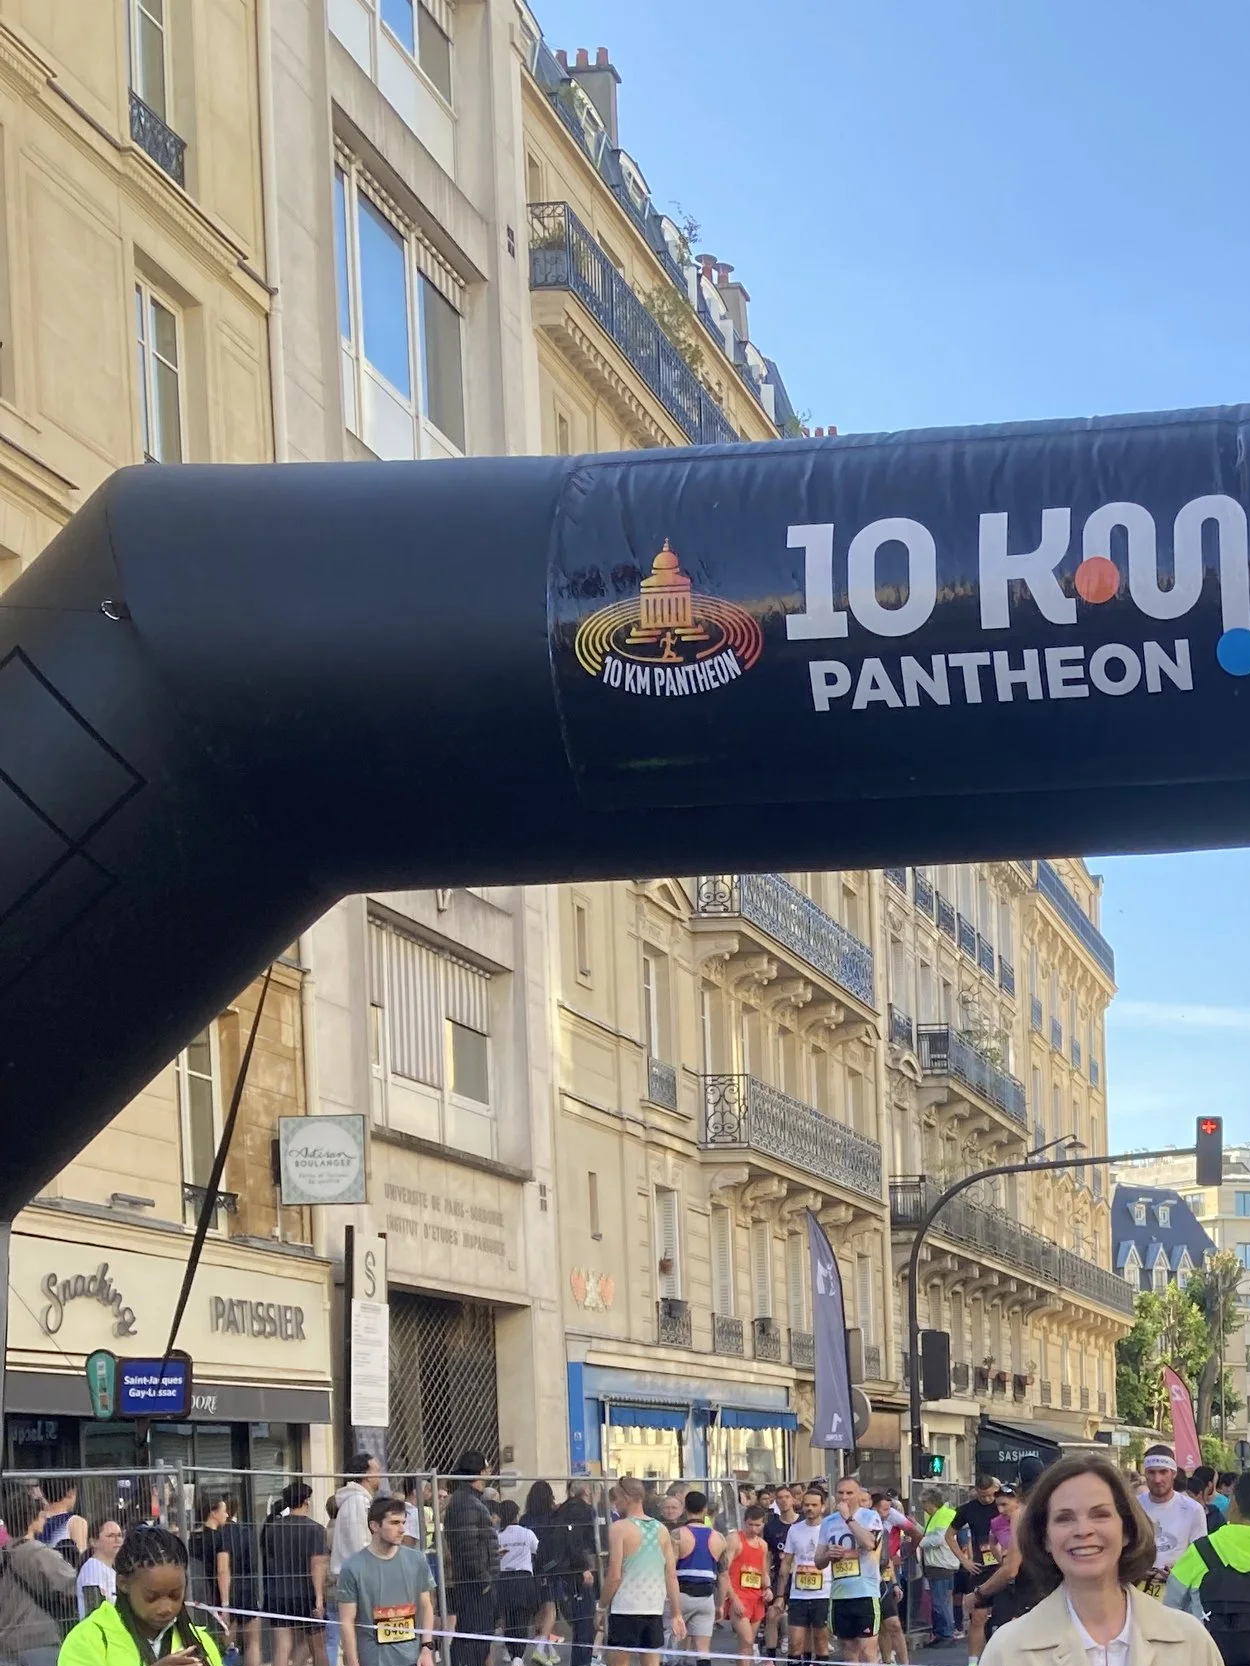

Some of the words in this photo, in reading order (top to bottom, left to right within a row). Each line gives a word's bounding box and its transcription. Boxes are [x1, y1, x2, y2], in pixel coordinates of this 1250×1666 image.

[786, 517, 937, 641] 10
[602, 655, 623, 688] 10
[624, 662, 651, 695] KM
[653, 648, 742, 697] PANTHEON
[808, 638, 1194, 712] PANTHEON
[294, 1159, 351, 1168] BOULANGER
[40, 1262, 138, 1339] Snacking
[209, 1295, 307, 1341] PATISSIER
[123, 1375, 183, 1386] Saint-Jaques
[800, 1576, 817, 1586] 4189
